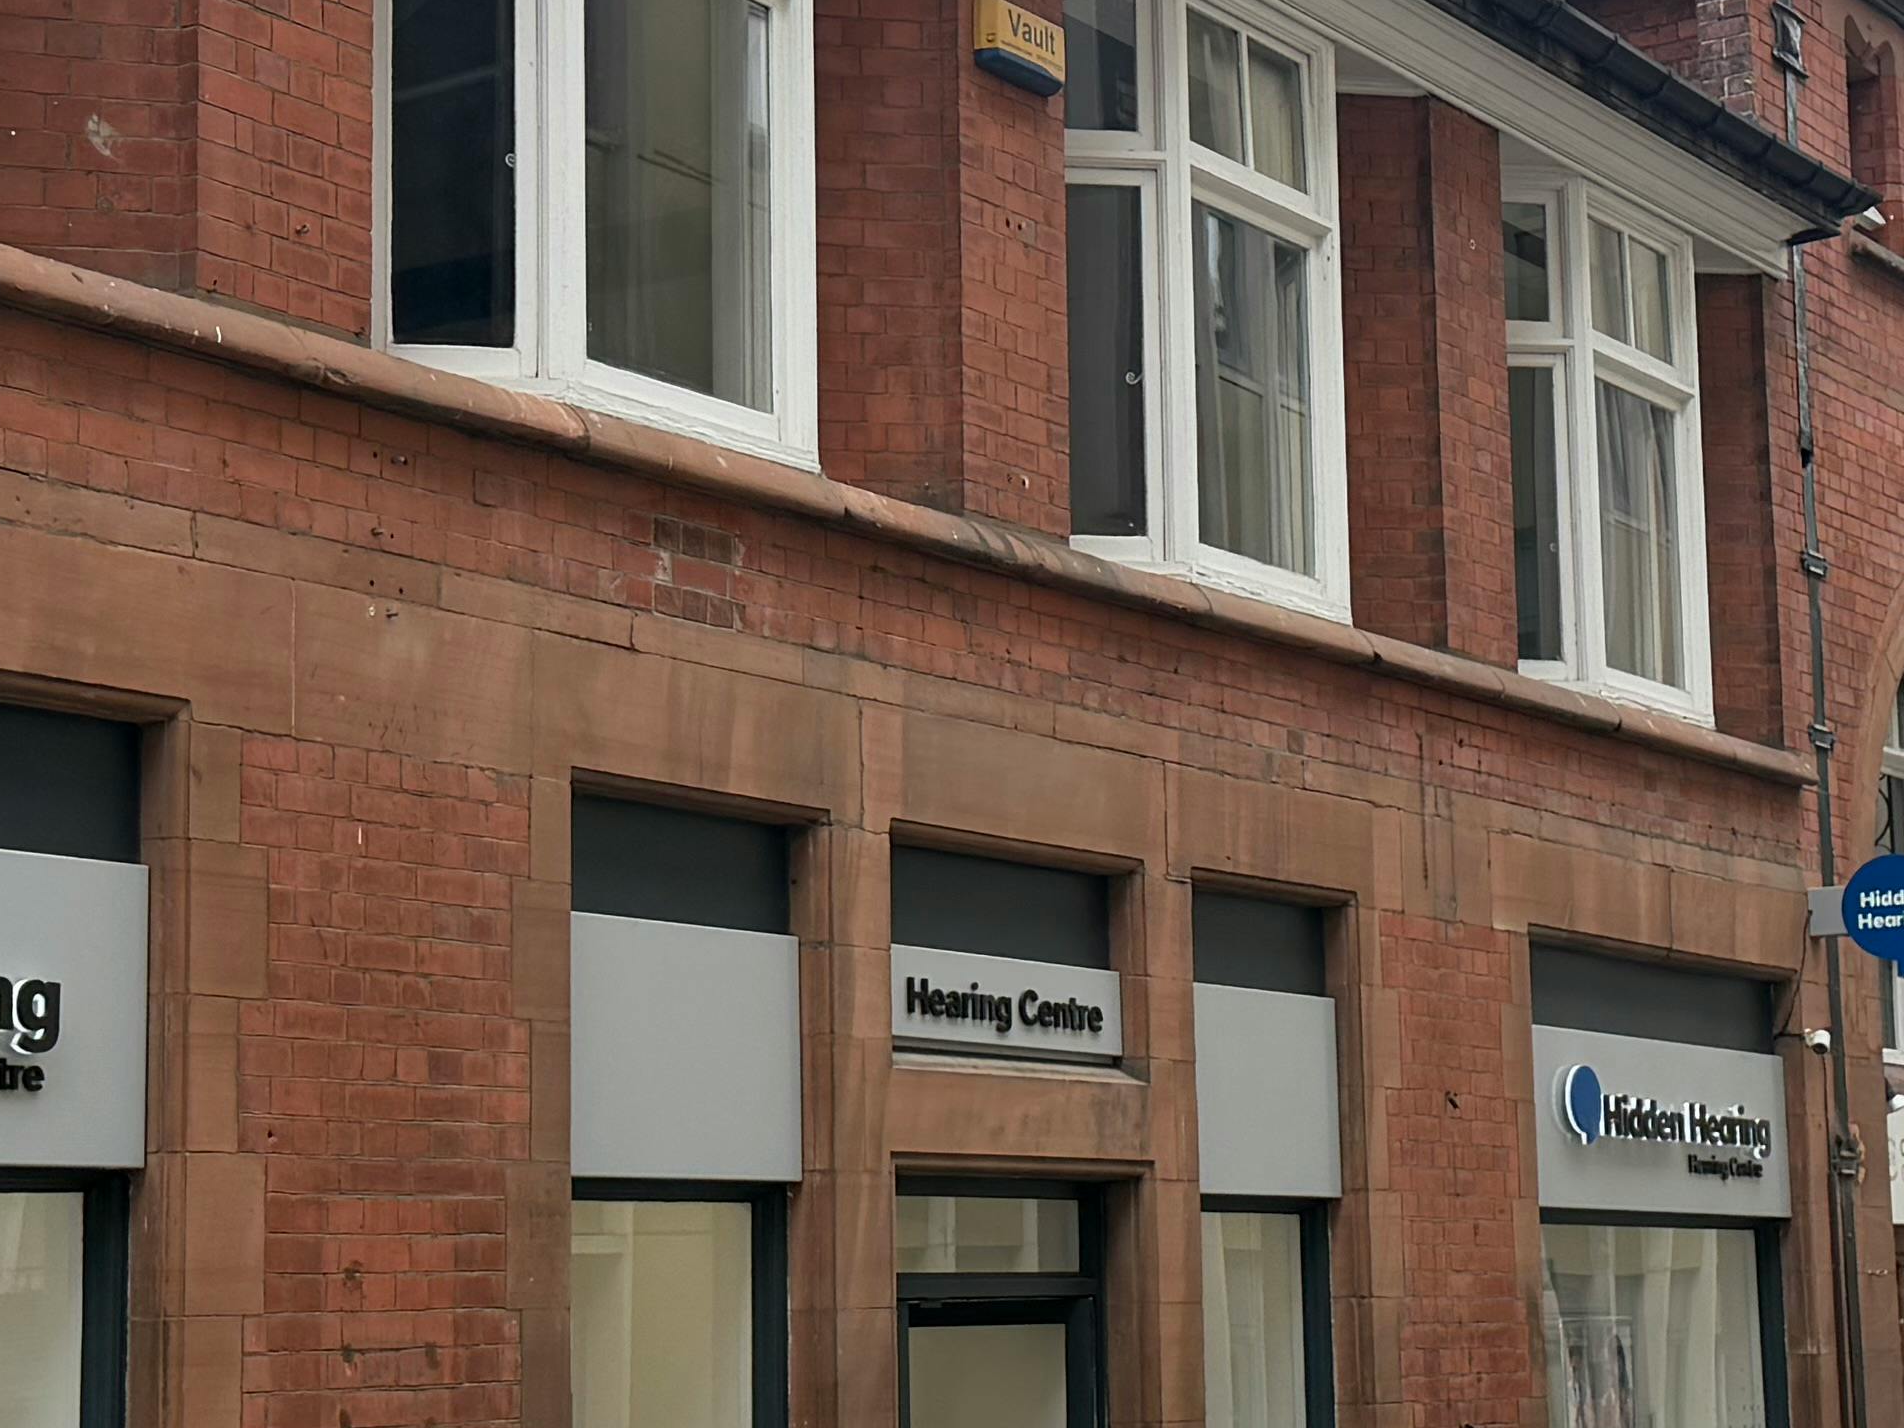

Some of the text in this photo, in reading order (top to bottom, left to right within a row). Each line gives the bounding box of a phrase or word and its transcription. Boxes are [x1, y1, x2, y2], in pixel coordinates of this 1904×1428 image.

[1008, 9, 1056, 55] Vault
[906, 976, 1104, 1033] Hearing Centre
[1601, 1093, 1772, 1160] Hidden Hearing
